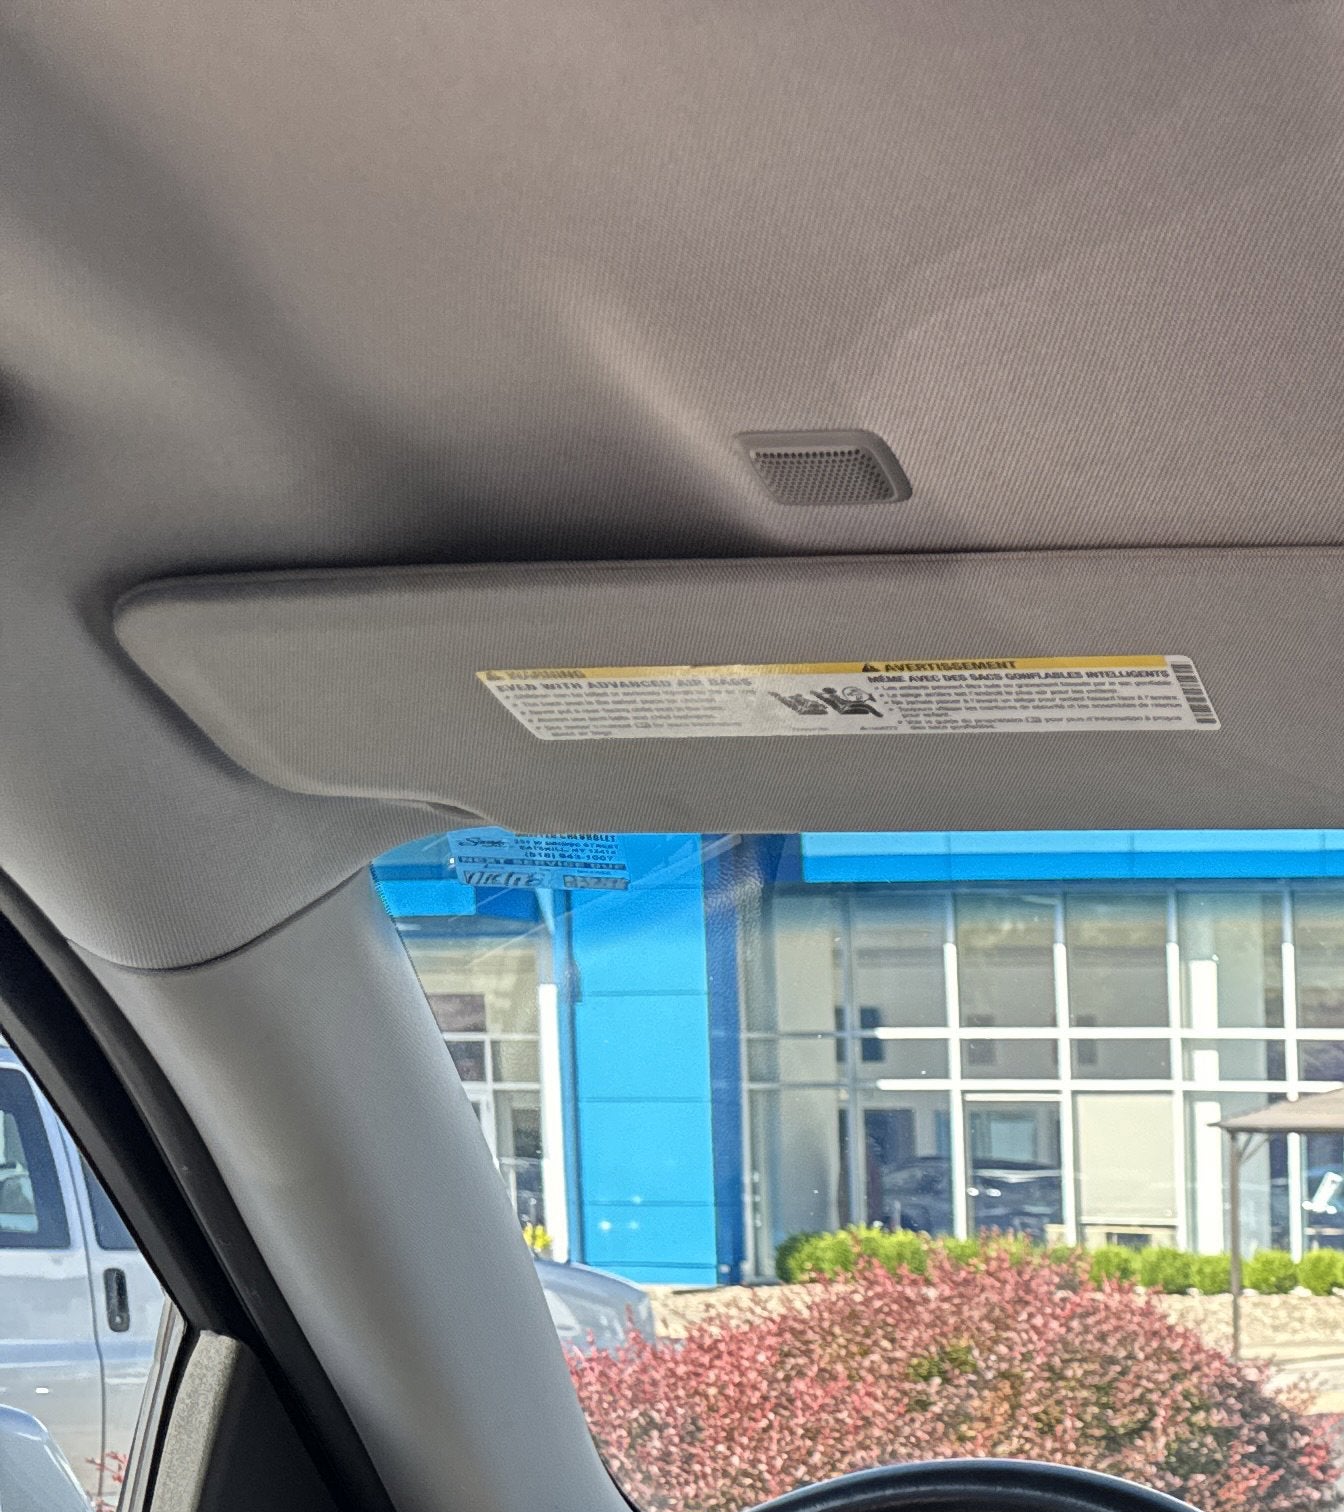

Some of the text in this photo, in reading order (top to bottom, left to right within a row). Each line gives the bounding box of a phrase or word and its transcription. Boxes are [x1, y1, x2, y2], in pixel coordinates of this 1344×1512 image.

[884, 661, 1016, 672] AVERTISSEMENT
[909, 674, 941, 682] AVEC
[943, 674, 967, 682] DES
[970, 673, 1002, 681] SACS
